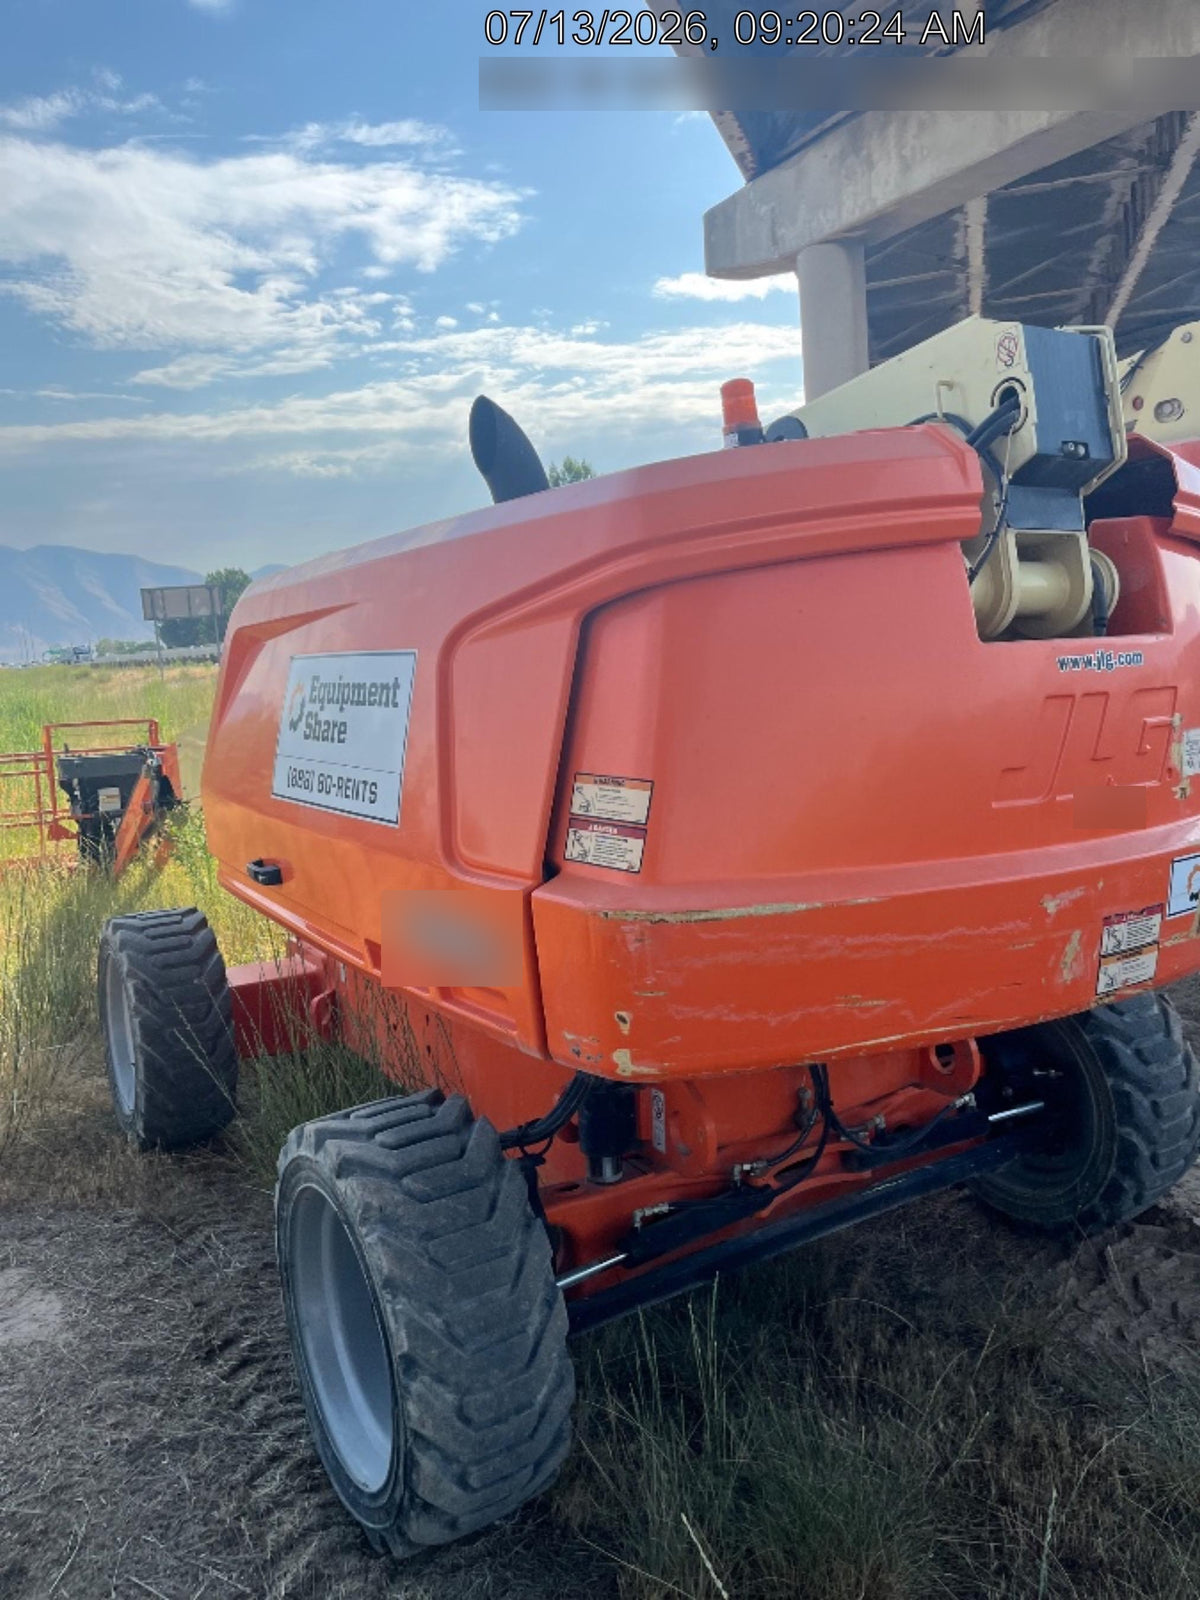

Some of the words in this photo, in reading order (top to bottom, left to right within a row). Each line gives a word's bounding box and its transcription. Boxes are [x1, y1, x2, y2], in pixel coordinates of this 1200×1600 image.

[1056, 649, 1144, 671] www.jlg.com
[308, 674, 401, 713] Equipment
[303, 710, 348, 744] Share
